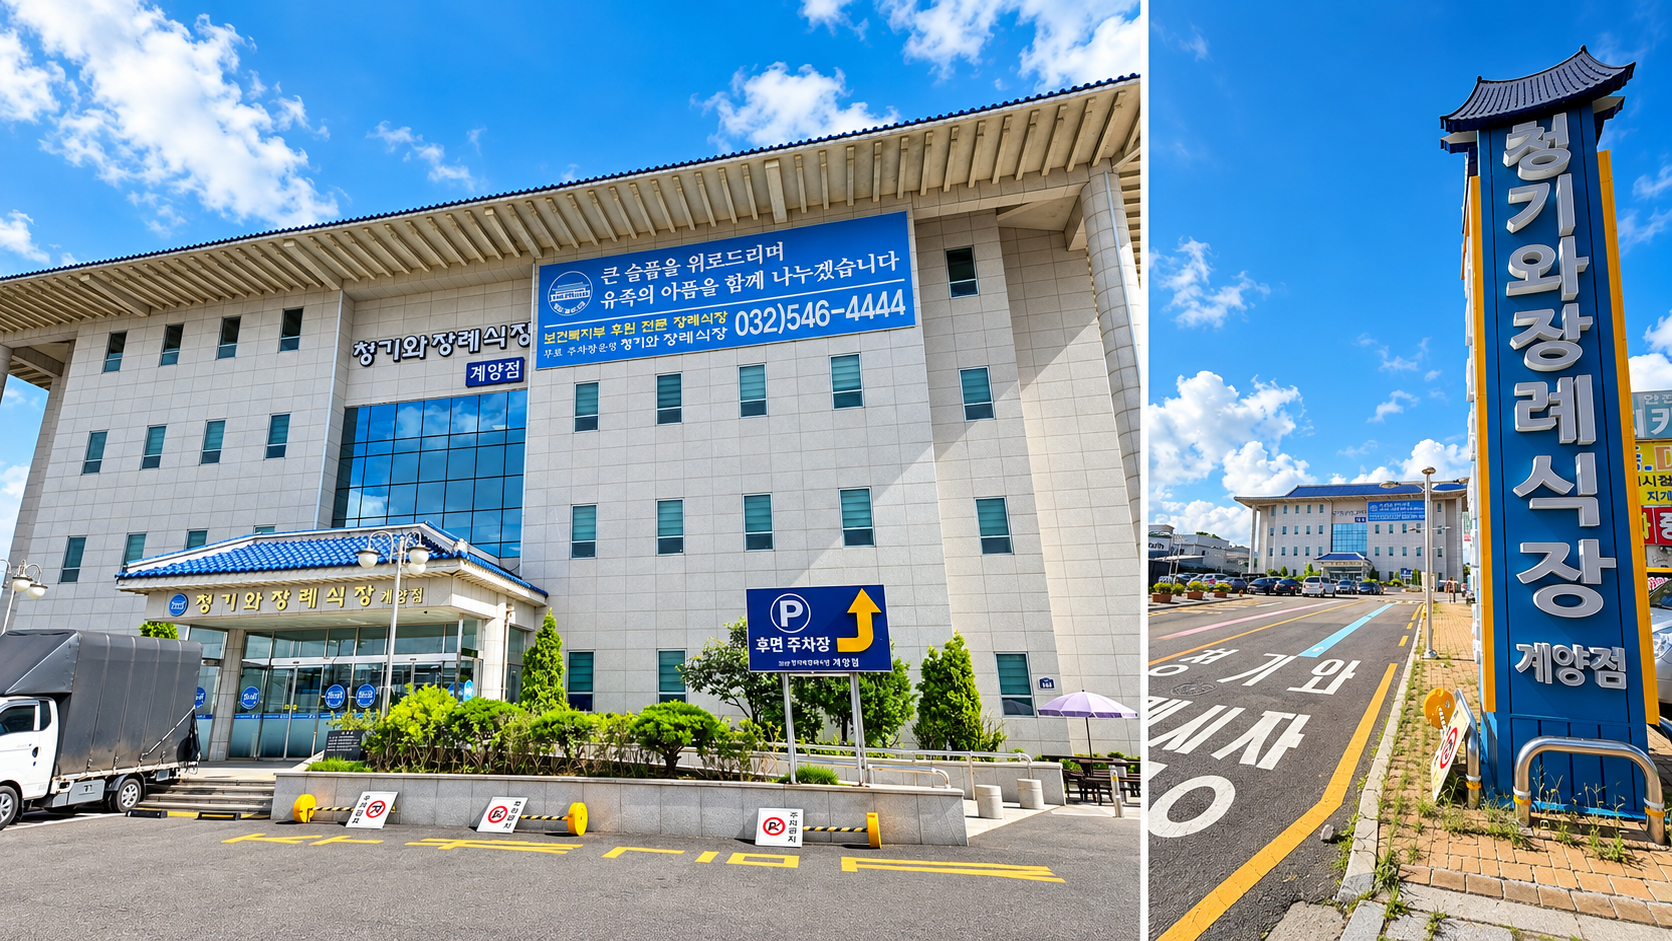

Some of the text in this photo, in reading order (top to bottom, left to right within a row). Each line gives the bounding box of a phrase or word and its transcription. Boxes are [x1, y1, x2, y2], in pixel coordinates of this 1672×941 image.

[600, 284, 654, 310] 유족의
[660, 277, 719, 302] 아픔을
[724, 270, 765, 294] 함께
[771, 250, 900, 288] 나누겠습니다
[601, 241, 784, 285] 큰 슬픔을 위로드리며
[673, 310, 728, 329] 장례식장
[734, 288, 906, 337] 032)546-4444
[663, 326, 728, 347] 장례식장
[470, 360, 520, 382] 계양점
[1502, 112, 1617, 618] 청기와장례식장
[779, 600, 803, 627] P
[755, 636, 830, 653] 후면 주차장
[1514, 642, 1627, 690] 계양점
